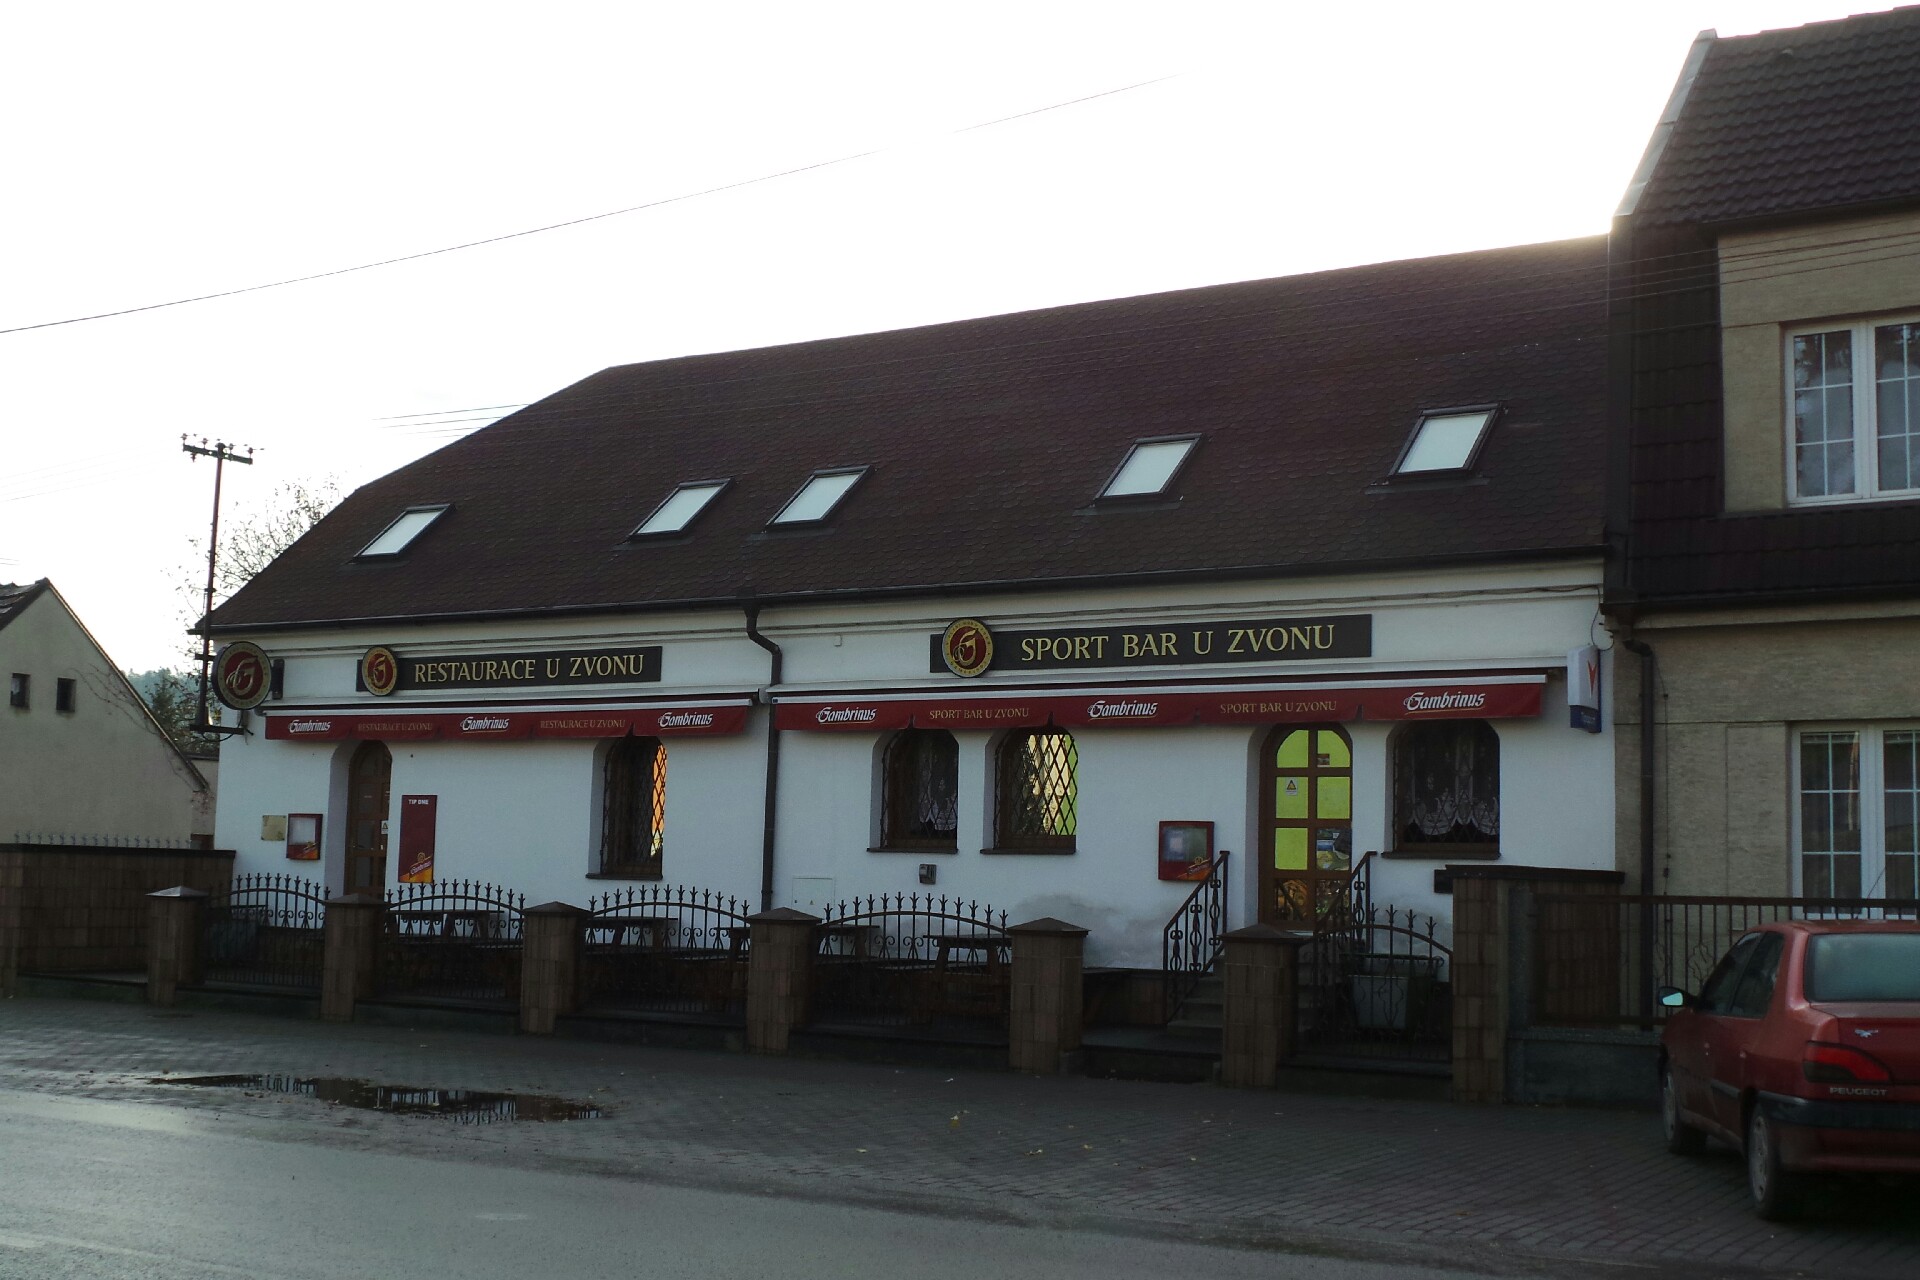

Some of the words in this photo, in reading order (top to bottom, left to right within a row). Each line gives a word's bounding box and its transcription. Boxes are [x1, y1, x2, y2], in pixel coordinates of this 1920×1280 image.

[1021, 636, 1109, 661] SPORT
[1122, 633, 1178, 658] BAR
[1193, 631, 1214, 655] U
[1227, 625, 1335, 653] ZVONU
[414, 659, 536, 683] RESTAURACE
[546, 658, 561, 679] U
[569, 654, 644, 677] ZVONU
[1087, 700, 1158, 717] Gambrinus
[1220, 703, 1257, 714] SPORT
[1260, 702, 1283, 713] BAR
[1285, 702, 1294, 712] U
[1296, 700, 1337, 712] ZVONU
[1403, 691, 1486, 711] Gambrinus
[658, 711, 713, 727] Gambrinus
[815, 706, 877, 722] Gambrinus
[929, 709, 961, 720] SPORT
[964, 709, 984, 719] BAR
[985, 709, 993, 718] U
[995, 707, 1030, 718] ZVONU
[288, 719, 332, 733] Gambrinus
[358, 723, 400, 732] RESTAURACE
[408, 722, 433, 731] ZVONU
[460, 716, 510, 732] Gambrinus
[540, 720, 588, 729] RESTAURACE
[589, 720, 596, 728] U
[597, 719, 626, 728] ZVONU
[1829, 1087, 1888, 1096] PEUGEOT
